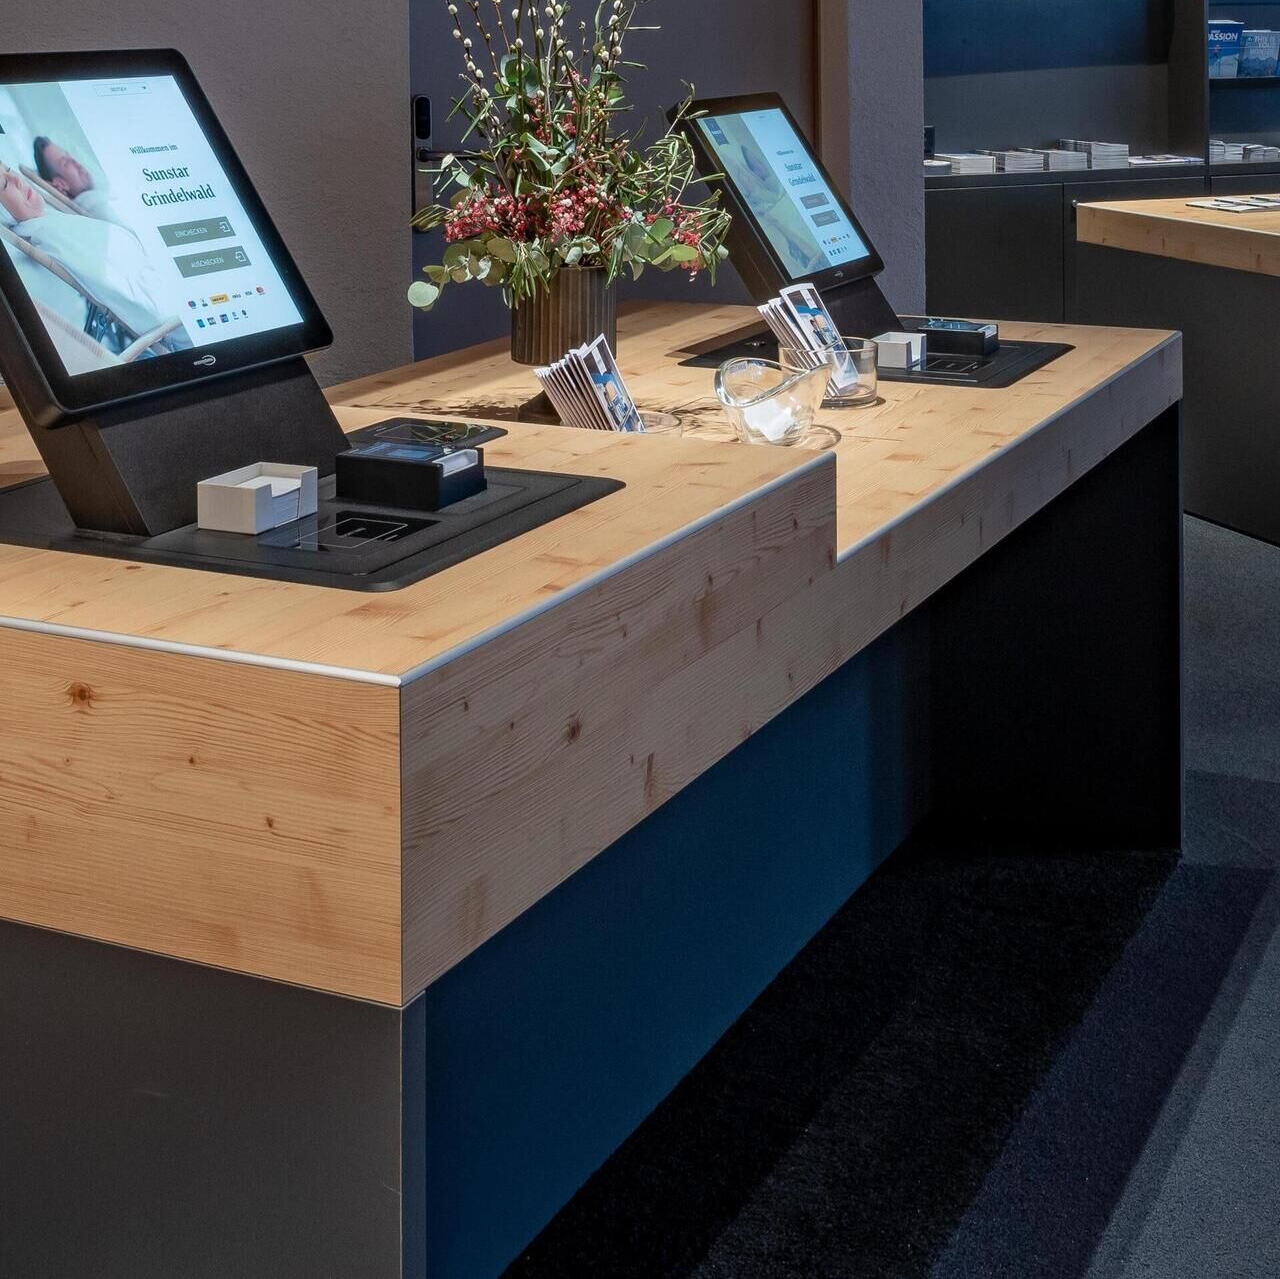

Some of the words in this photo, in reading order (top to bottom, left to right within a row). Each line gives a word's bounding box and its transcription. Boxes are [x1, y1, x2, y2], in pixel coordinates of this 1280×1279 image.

[129, 145, 169, 154] Willkommen
[168, 143, 178, 152] im
[142, 166, 190, 182] Sunstar
[141, 183, 216, 207] Grindelwald
[174, 226, 209, 238] EINCHECKEN
[190, 257, 225, 269] AUSCHECKEN
